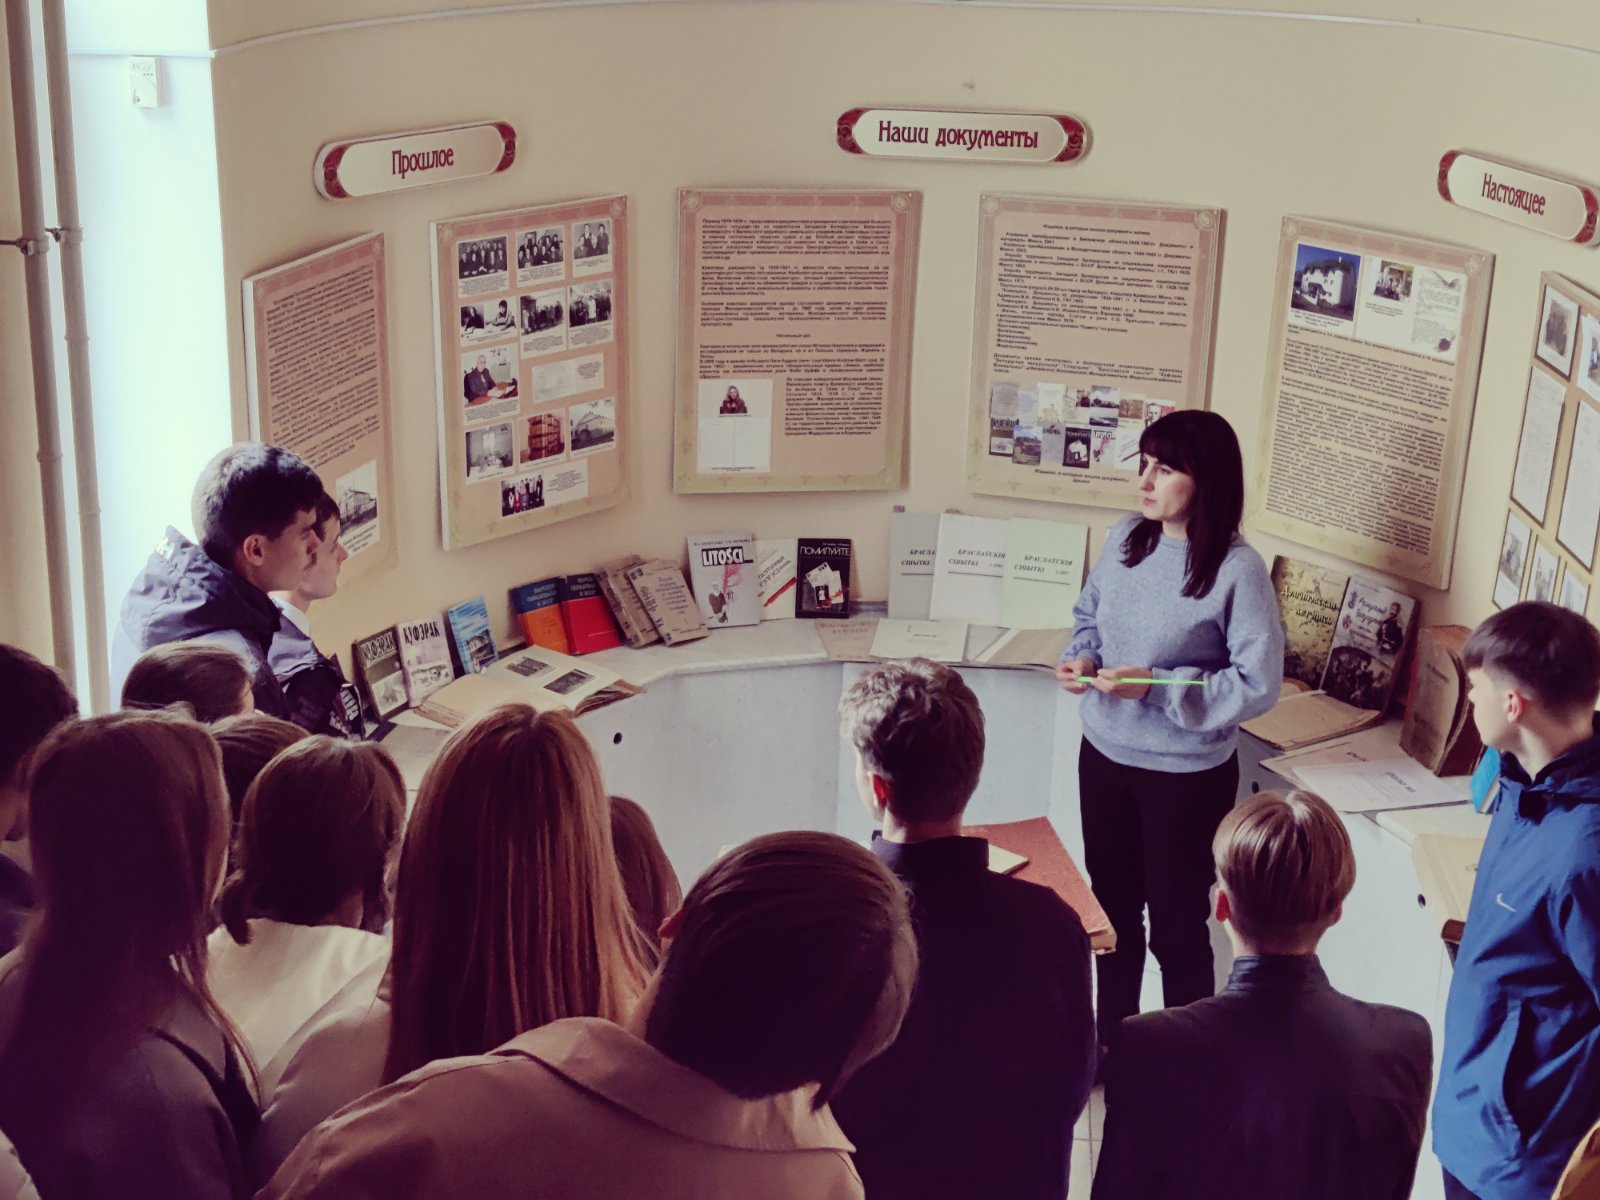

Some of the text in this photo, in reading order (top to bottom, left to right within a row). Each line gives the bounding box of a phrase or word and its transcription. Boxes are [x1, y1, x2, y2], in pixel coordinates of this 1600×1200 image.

[879, 120, 1039, 150] Наши документы
[392, 148, 454, 179] Прошлое
[1481, 173, 1546, 215] Настоящее
[909, 548, 936, 556] БРАСЛА
